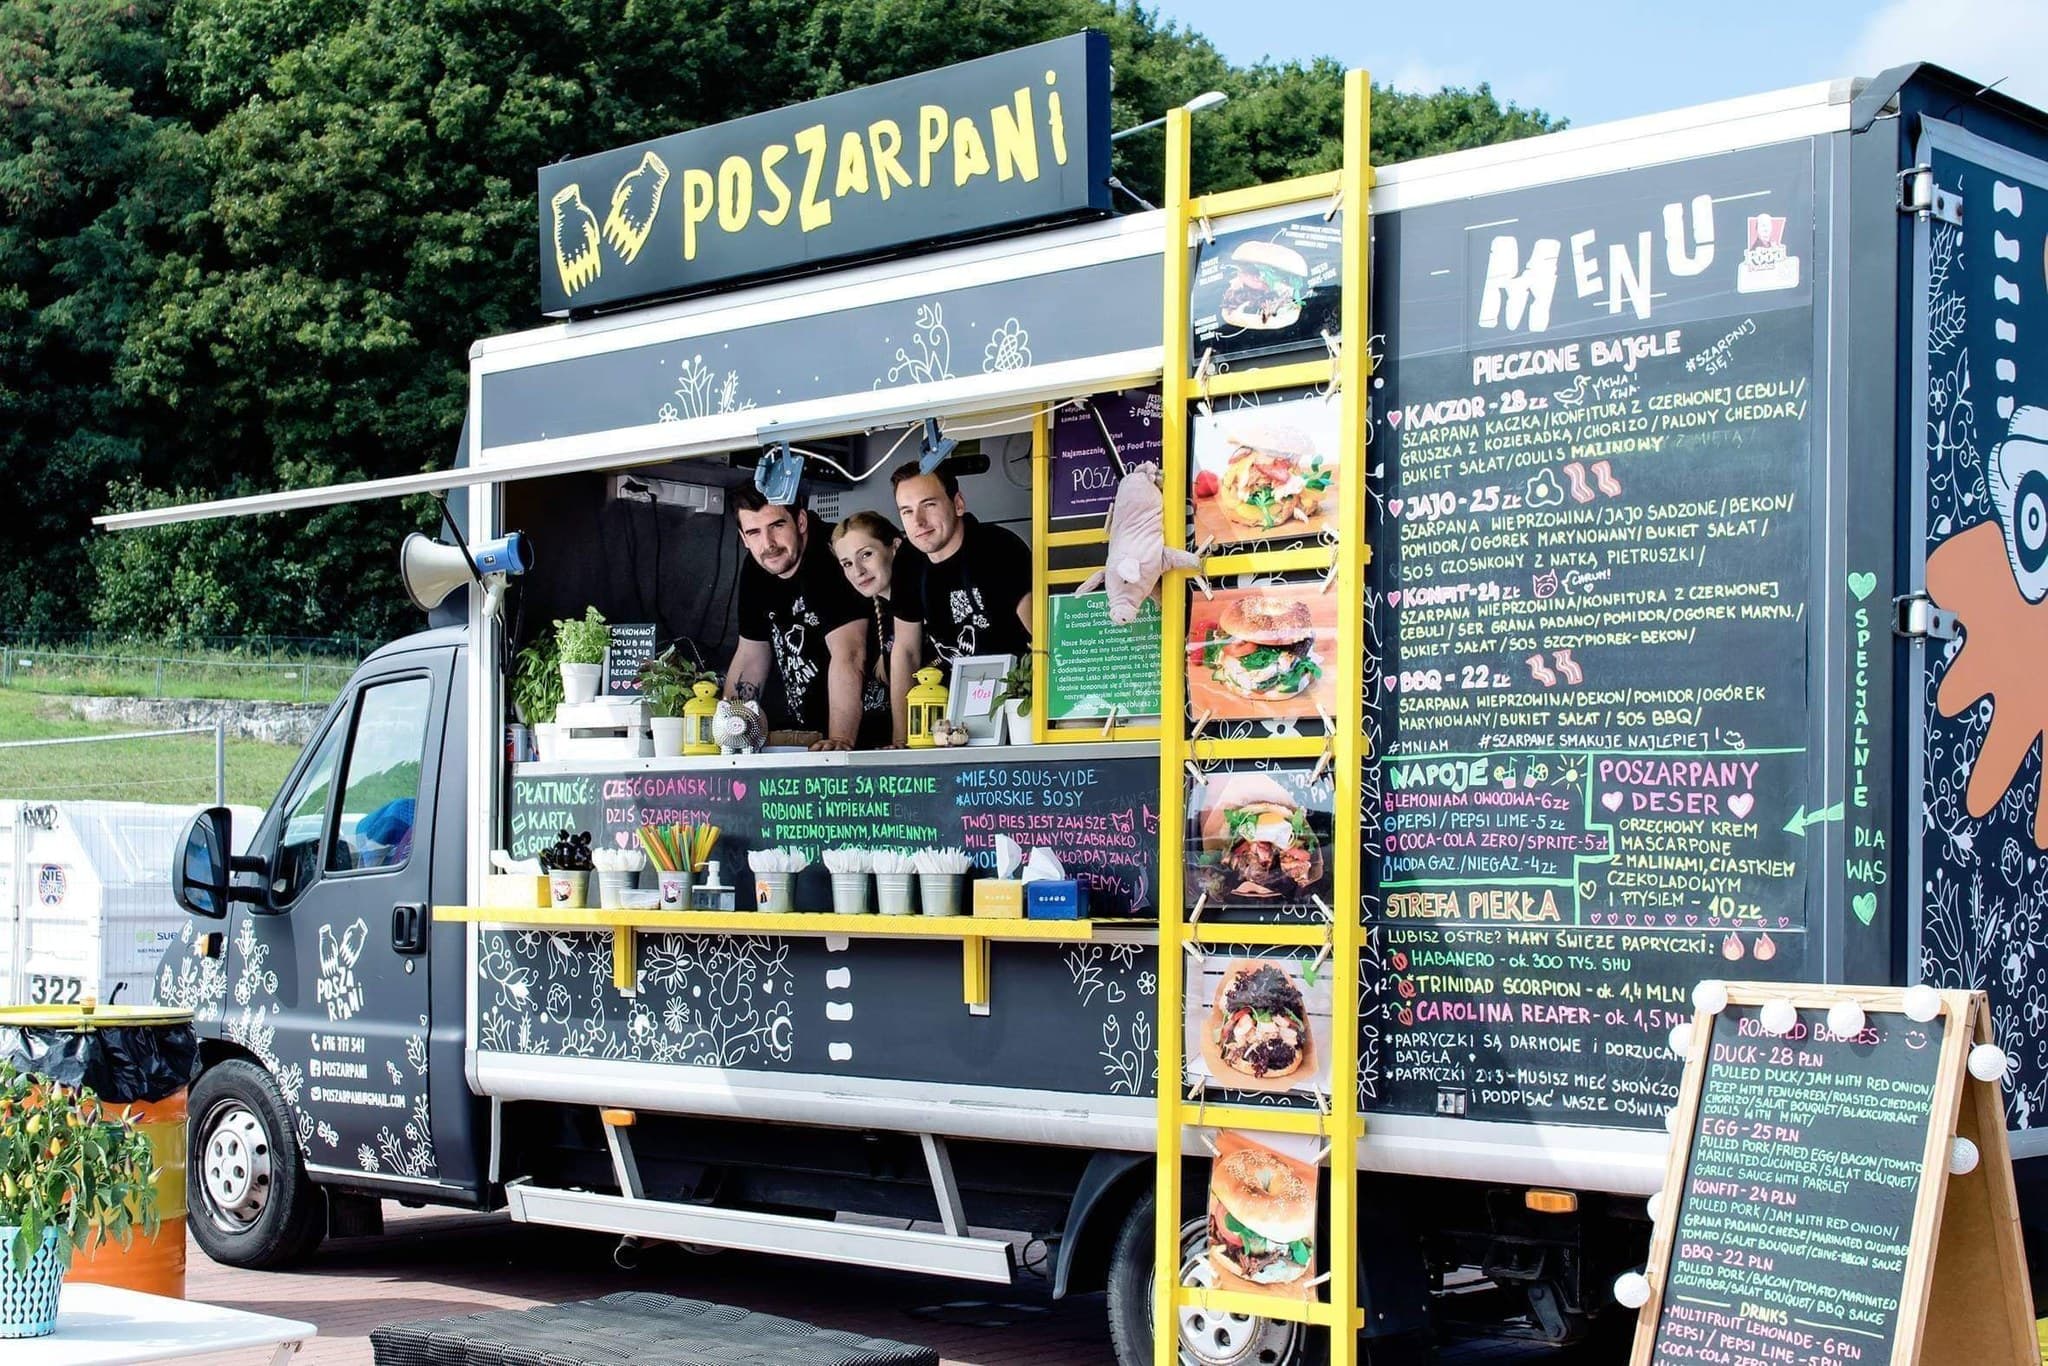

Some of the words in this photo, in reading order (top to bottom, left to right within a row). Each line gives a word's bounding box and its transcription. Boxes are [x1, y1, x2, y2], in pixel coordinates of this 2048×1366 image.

[1478, 194, 1714, 331] MENU
[1685, 318, 1757, 373] #SZARPNIJ
[1473, 344, 1580, 386] PIECZONE
[1590, 330, 1681, 372] BAJGLE
[1402, 424, 1479, 448] SZARPANA
[1648, 387, 1731, 410] CZERWONEJ
[1404, 396, 1485, 430] KACZOR
[1400, 443, 1462, 467] GRUSZKA
[1484, 431, 1572, 451] KOZIERADKĄ
[1583, 418, 1647, 439] CHORIZO
[1662, 409, 1719, 430] PALONY
[1402, 464, 1452, 486] BUKIET
[1570, 437, 1663, 459] MALINOWY
[1405, 491, 1457, 520] JAJO
[1469, 486, 1500, 513] 25
[1401, 518, 1480, 541] SZARPANA
[1647, 500, 1718, 521] SADZONE
[1402, 563, 1433, 581] SOS
[1440, 553, 1524, 575] CZOSNKOWY
[1550, 551, 1598, 570] NATKĄ
[1400, 606, 1470, 627] SZARPANA
[1689, 581, 1779, 600] CZERWONEJ
[1458, 622, 1484, 637] SER
[1491, 620, 1535, 635] GRANA
[1401, 643, 1451, 660] BUKIET
[1461, 664, 1489, 690] 22
[1400, 696, 1469, 714] SZARPANA
[1616, 711, 1646, 727] SOS
[1478, 733, 1555, 750] #SZARPANE
[1559, 733, 1622, 749] SMAKUJE
[759, 779, 799, 797] NASZE
[805, 778, 849, 799] BAJGLE
[856, 775, 874, 798] SĄ
[879, 776, 936, 797] RĘCZNIE
[1012, 769, 1099, 787] SOUS-VIDE
[1390, 757, 1489, 793] NAPOJE
[1600, 760, 1759, 790] POSZARPANY
[603, 777, 641, 800] CZEŚĆ
[1043, 790, 1085, 808] SOSY
[762, 802, 814, 821] ROBIONE
[1395, 793, 1468, 809] LEMONIADA
[1632, 791, 1720, 815] DESER
[528, 810, 576, 831] KARTA
[606, 804, 636, 824] DZIŚ
[961, 812, 995, 831] TWÓJ
[999, 814, 1025, 830] PIES
[1028, 814, 1054, 830] JEST
[1057, 816, 1107, 832] ZAWSZE
[1397, 813, 1436, 831] PEPSI
[1451, 812, 1490, 829] PEPSI
[1620, 818, 1705, 834] ORZECHOWY
[1712, 822, 1758, 839] KREM
[1076, 837, 1136, 848] ZABRAKŁO
[1400, 834, 1476, 852] COCA-COLA
[1621, 836, 1732, 856] MASCARPONE
[1855, 826, 1886, 850] DLA
[42, 870, 62, 881] NIE
[1393, 857, 1426, 871] WODA
[1846, 859, 1887, 885] WAS
[1608, 870, 1742, 893] CZEKOLADOWYM
[1385, 890, 1461, 918] STREFA
[1468, 889, 1561, 922] PIEKŁA
[1621, 892, 1684, 907] PTYSIEM
[1709, 897, 1736, 918] 10
[1388, 930, 1440, 944] LUBISZ
[1444, 930, 1501, 944] OSTRE?
[1507, 928, 1549, 945] MAMY
[1411, 949, 1495, 968] HABANERO
[1532, 953, 1563, 968] 300
[1601, 957, 1631, 972] SHU
[32, 974, 81, 1005] 322
[1503, 978, 1581, 997] SCORPION
[1646, 983, 1686, 1004] MLN
[1416, 1000, 1514, 1022] CAROLINA
[1522, 1003, 1591, 1025] REAPER
[1395, 1032, 1475, 1049] PAPRYCZKI
[1483, 1034, 1502, 1053] SĄ
[1510, 1034, 1581, 1053] DARMOWE
[1768, 1046, 1794, 1065] 28
[1799, 1053, 1823, 1068] PLN
[1574, 1073, 1607, 1091] MIEĆ
[1711, 1064, 1760, 1081] PULLED
[1836, 1073, 1862, 1088] WITH
[1867, 1076, 1889, 1092] RED
[1482, 1089, 1554, 1107] PODPISAĆ
[1562, 1094, 1608, 1112] WASZE
[1699, 1135, 1740, 1150] PULLED
[1702, 1118, 1738, 1137] EGG
[1751, 1122, 1771, 1138] 25
[1776, 1129, 1799, 1143] PLN
[1697, 1149, 1758, 1167] MARINATED
[1694, 1163, 1733, 1178] GARLIC
[1738, 1167, 1772, 1182] SAUCE
[1776, 1173, 1799, 1186] WITH
[1802, 1176, 1849, 1194] PARSLEY
[1692, 1179, 1739, 1197] KONFIT
[1771, 1190, 1797, 1205] PLN
[1684, 1214, 1722, 1228] GRANA
[1689, 1197, 1727, 1213] PULLED
[1730, 1202, 1760, 1217] PORK
[1795, 1214, 1823, 1229] WITH
[1826, 1216, 1849, 1231] RED
[1677, 1260, 1714, 1276] PULLED
[1681, 1244, 1713, 1261] BBQ
[1725, 1249, 1744, 1267] 22
[1748, 1254, 1773, 1271] PLN
[1739, 1302, 1789, 1326] DRINKS
[1849, 1309, 1885, 1326] SAUCE
[1666, 1325, 1704, 1342] PEPSI
[1720, 1333, 1756, 1353] PEPSI
[1761, 1345, 1794, 1365] LIME
[1670, 1307, 1743, 1330] MULTIFRUIT
[1746, 1319, 1814, 1348] LEMONADE
[1837, 1343, 1862, 1361] PLN
